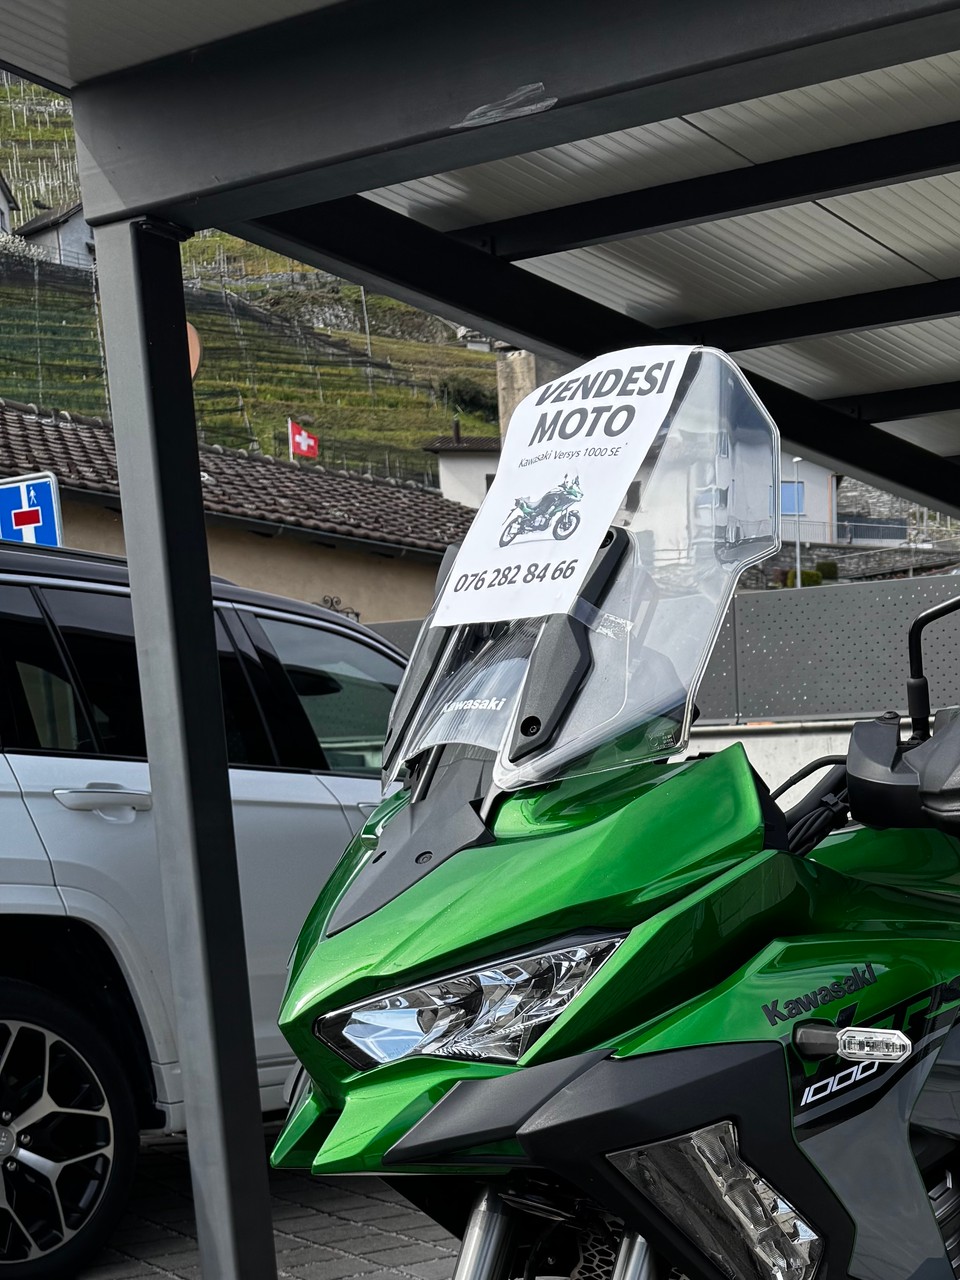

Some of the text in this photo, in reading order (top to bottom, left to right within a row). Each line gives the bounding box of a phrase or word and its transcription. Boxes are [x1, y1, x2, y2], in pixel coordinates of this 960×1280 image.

[535, 360, 675, 406] VENDESI
[528, 404, 636, 447] MOTO
[518, 446, 622, 468] Kawasaki Versys 1000 SE
[454, 559, 579, 592] 076 282 84 66
[761, 961, 878, 1026] Kawasaki
[800, 1060, 879, 1106] 1000
